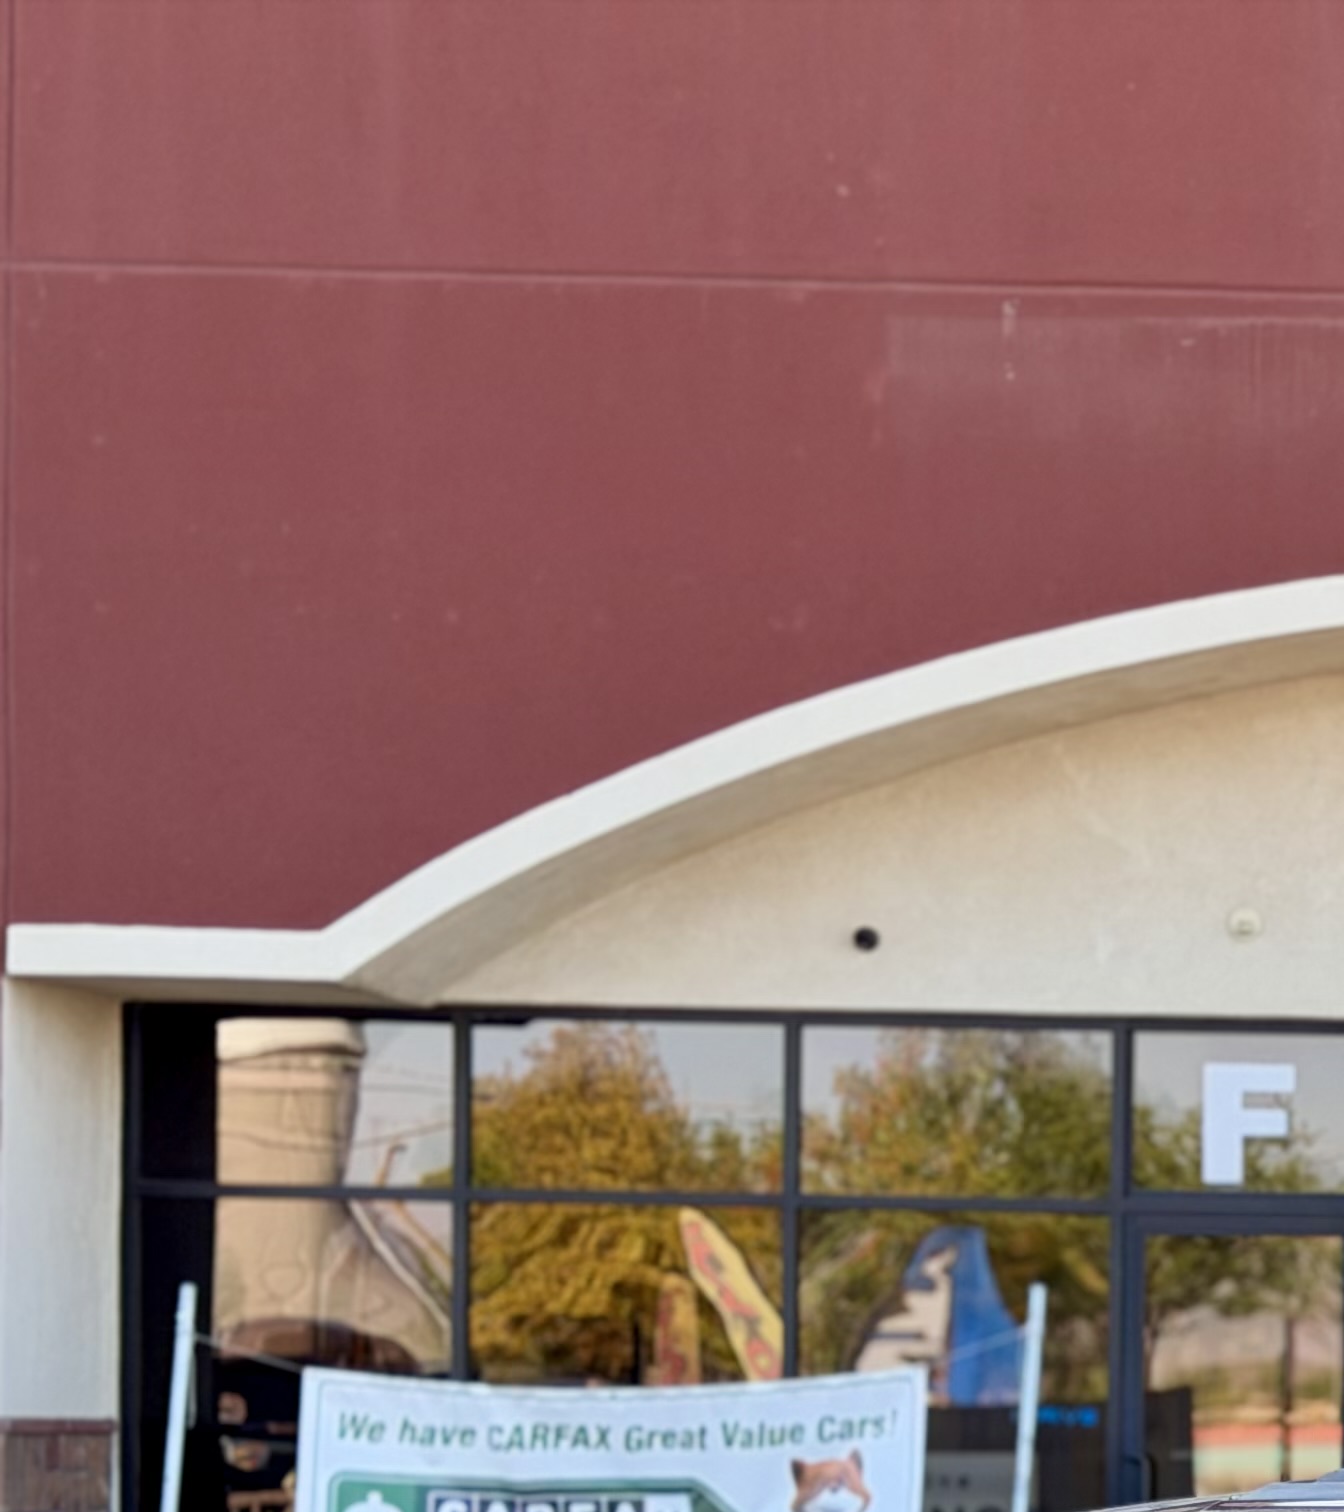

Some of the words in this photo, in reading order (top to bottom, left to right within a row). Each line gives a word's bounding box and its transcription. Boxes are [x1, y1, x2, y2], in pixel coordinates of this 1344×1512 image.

[1202, 1061, 1297, 1184] F
[337, 1412, 386, 1443] We
[399, 1416, 476, 1448] have
[487, 1422, 612, 1451] CARFAX
[624, 1424, 707, 1452] Great
[721, 1419, 806, 1449] Value
[817, 1409, 898, 1445] Cars!
